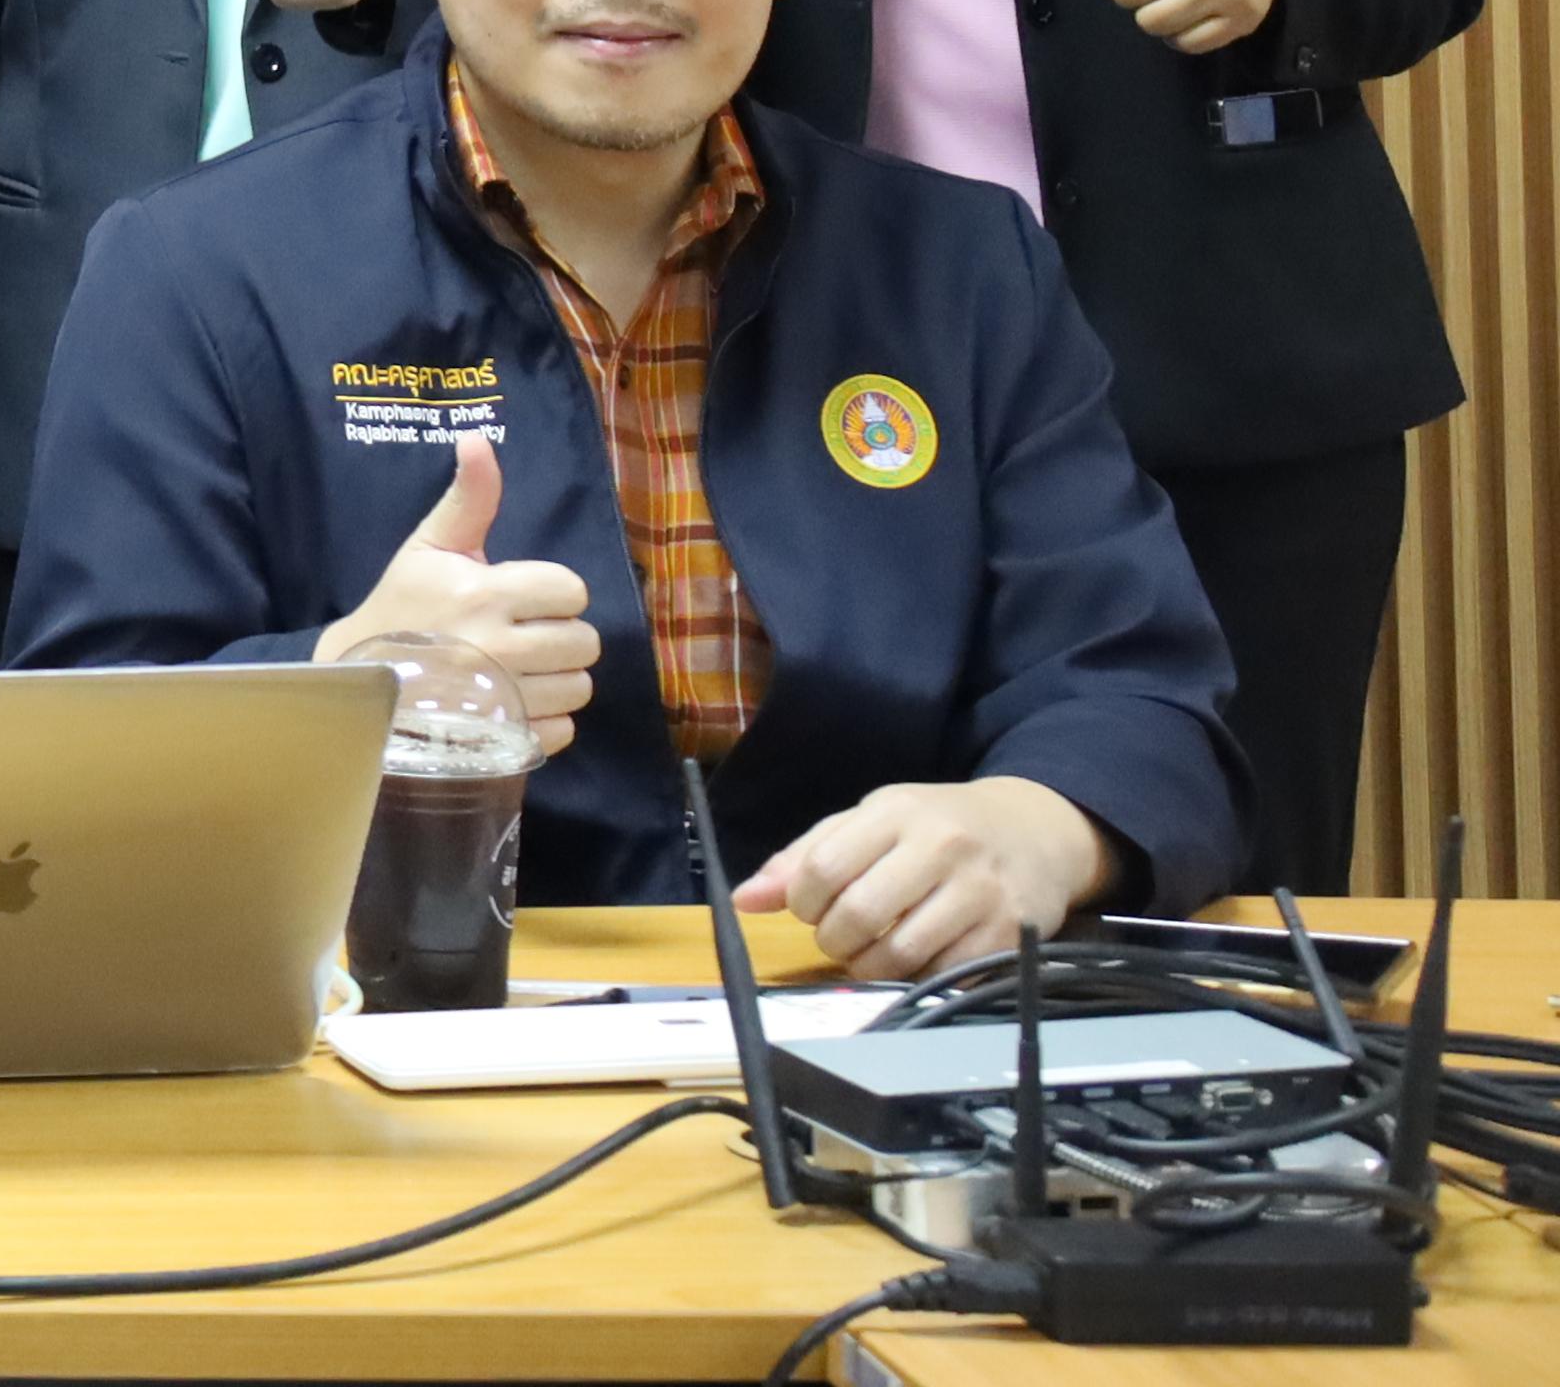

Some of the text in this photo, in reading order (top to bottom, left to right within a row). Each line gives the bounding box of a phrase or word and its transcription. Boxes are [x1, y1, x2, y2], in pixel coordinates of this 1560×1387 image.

[332, 357, 498, 398] คณะครุศาสตร์
[345, 402, 496, 426] Kamphaeng phet
[345, 423, 420, 445] Rajabhat
